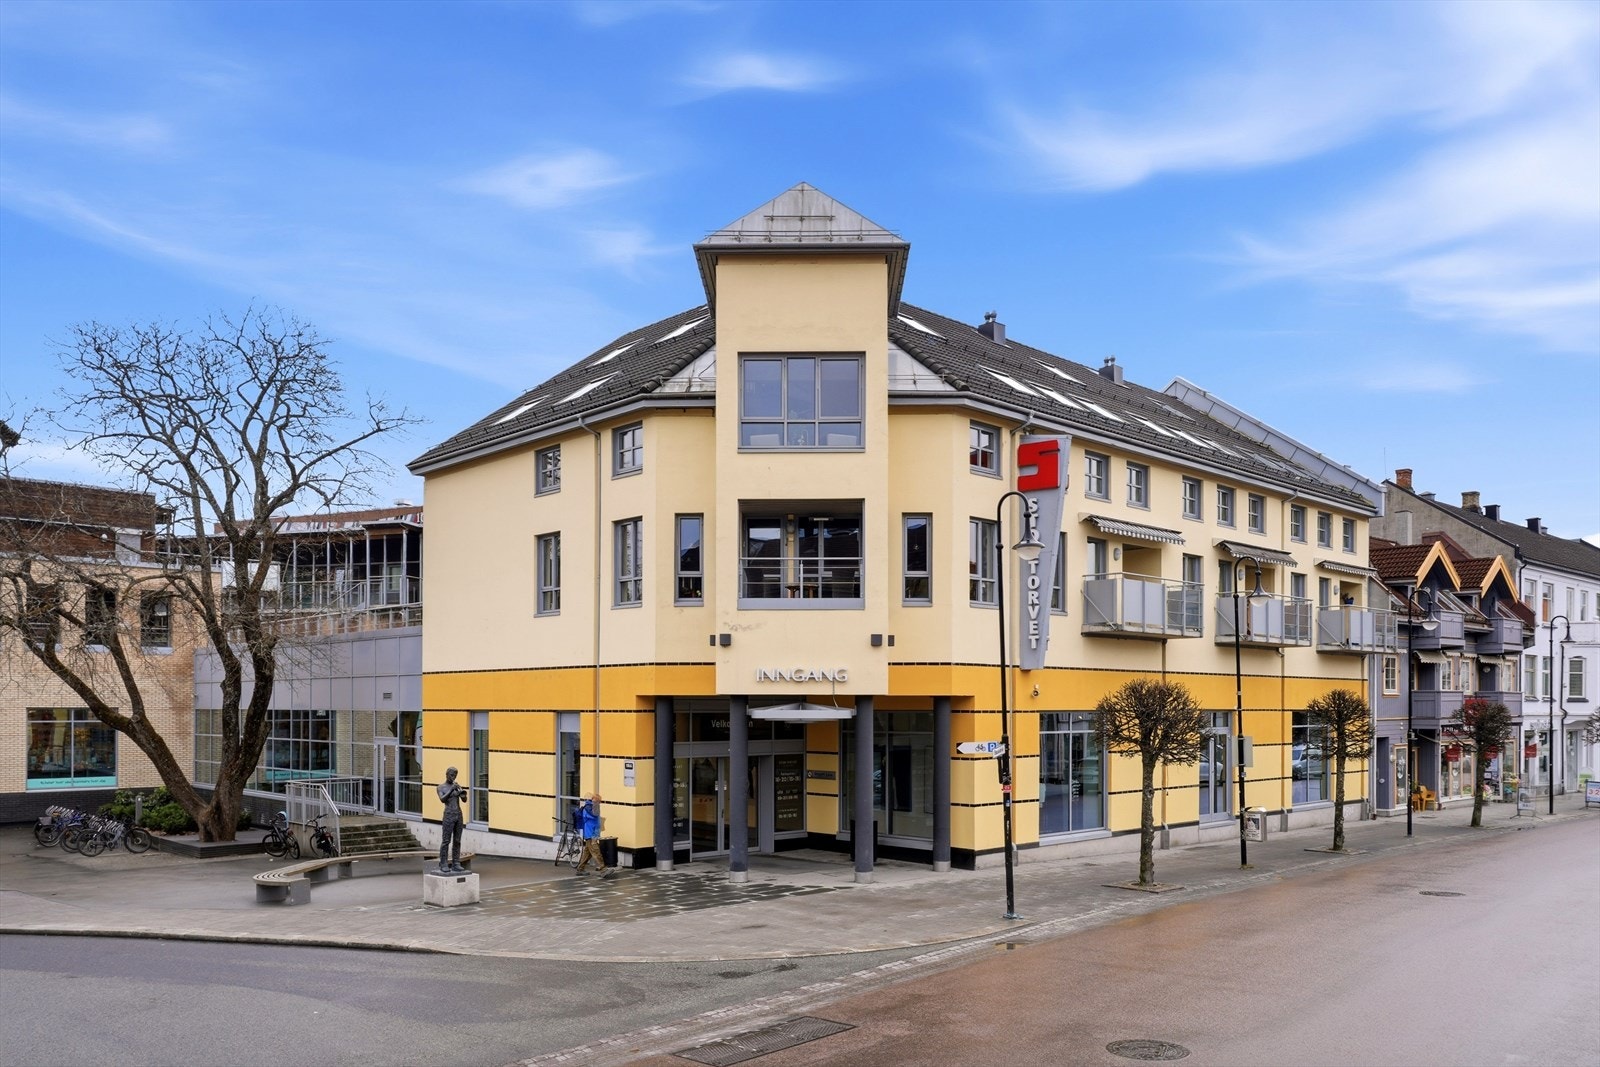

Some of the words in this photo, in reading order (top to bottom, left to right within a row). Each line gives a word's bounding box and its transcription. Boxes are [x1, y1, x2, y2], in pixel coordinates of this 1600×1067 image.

[1027, 497, 1040, 649] STOTORVET
[756, 667, 848, 682] INNGANG
[711, 719, 753, 728] Velkon
